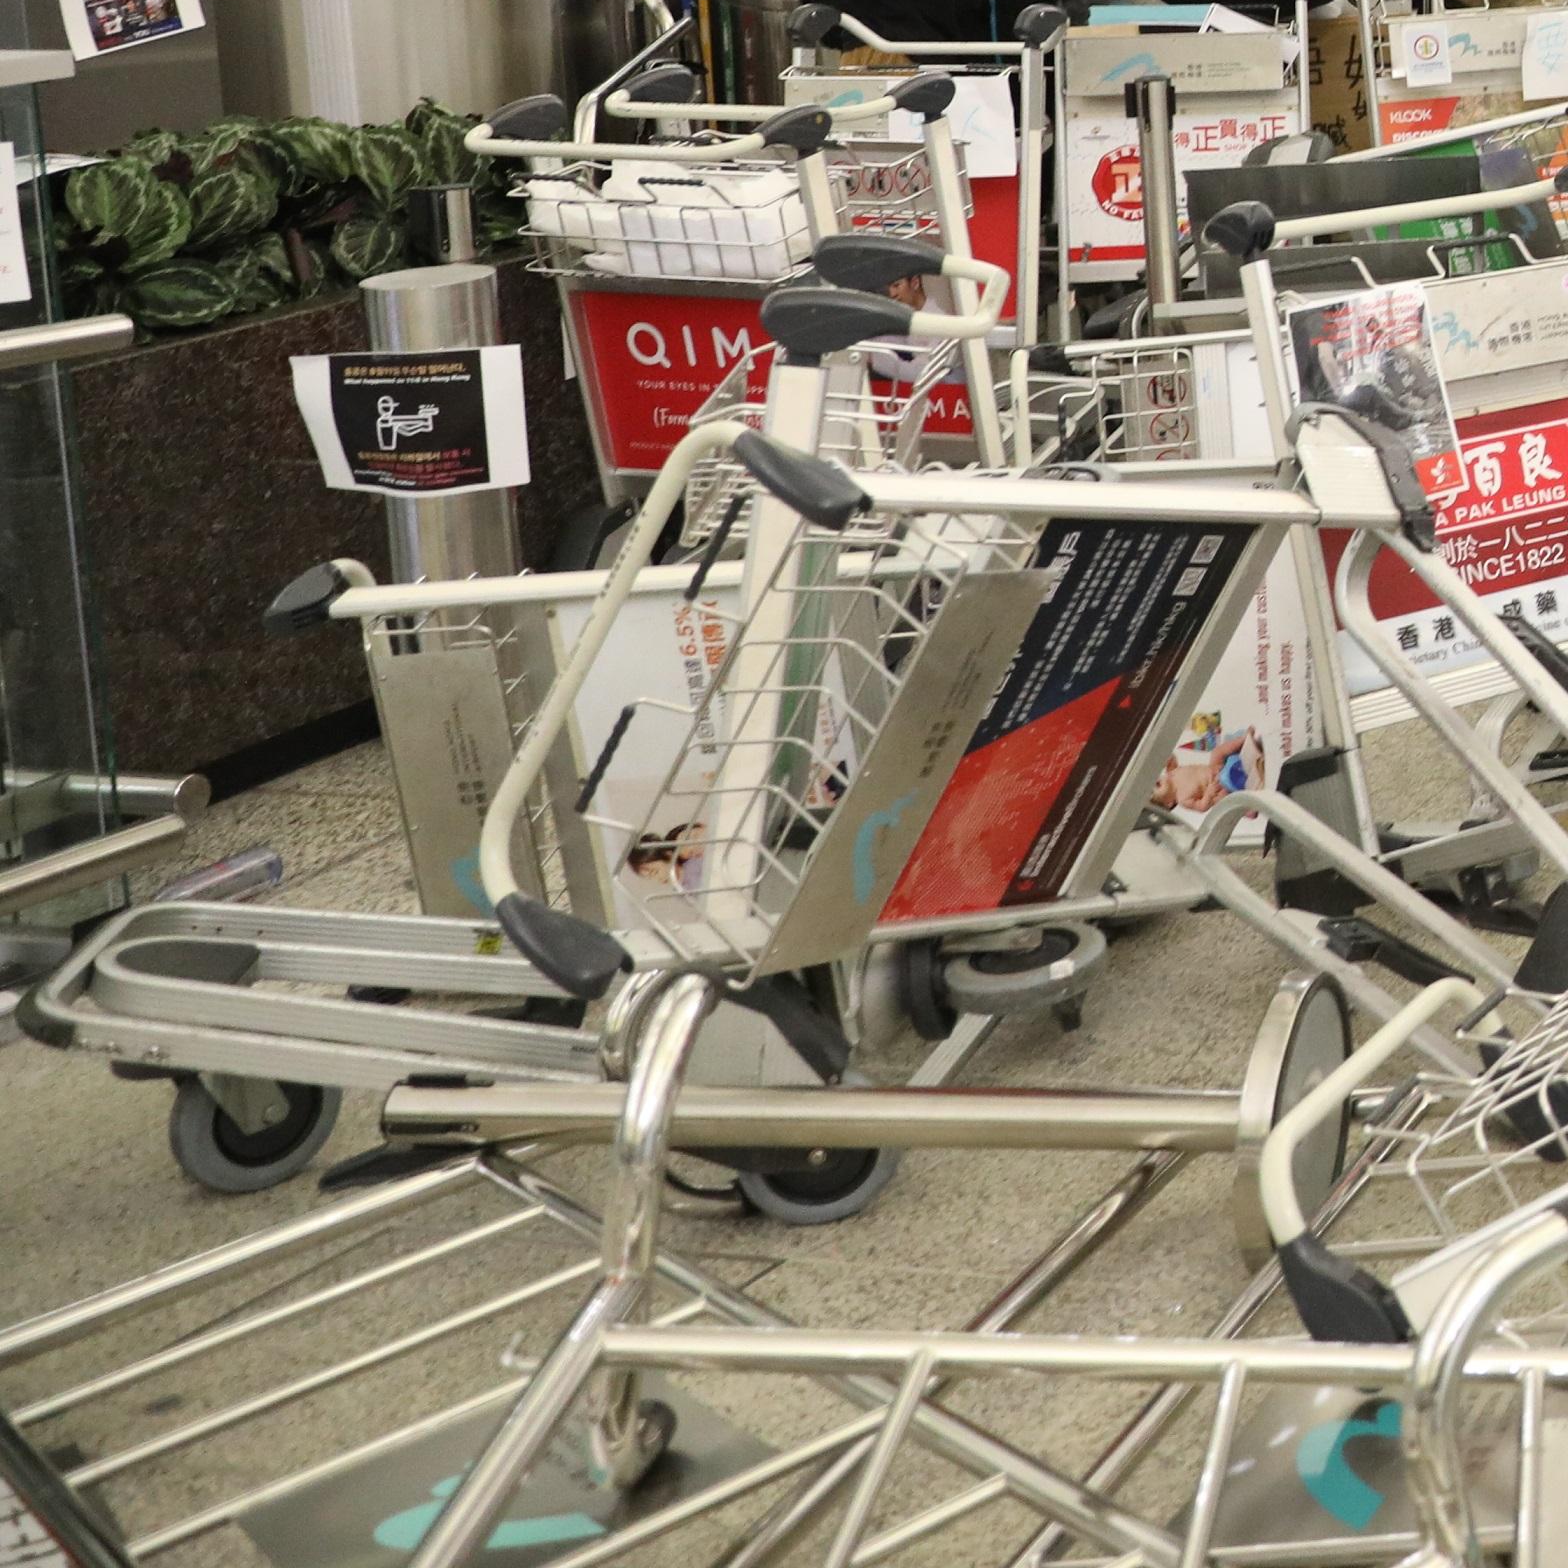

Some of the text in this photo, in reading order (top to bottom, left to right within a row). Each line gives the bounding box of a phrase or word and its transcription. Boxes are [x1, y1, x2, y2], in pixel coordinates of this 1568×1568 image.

[1390, 107, 1433, 124] KLOOK
[626, 321, 757, 371] QIM
[1426, 432, 1563, 508] 百良
[1455, 501, 1496, 523] PAK
[1501, 484, 1567, 513] LEUNG
[1453, 541, 1566, 587] INCE1822
